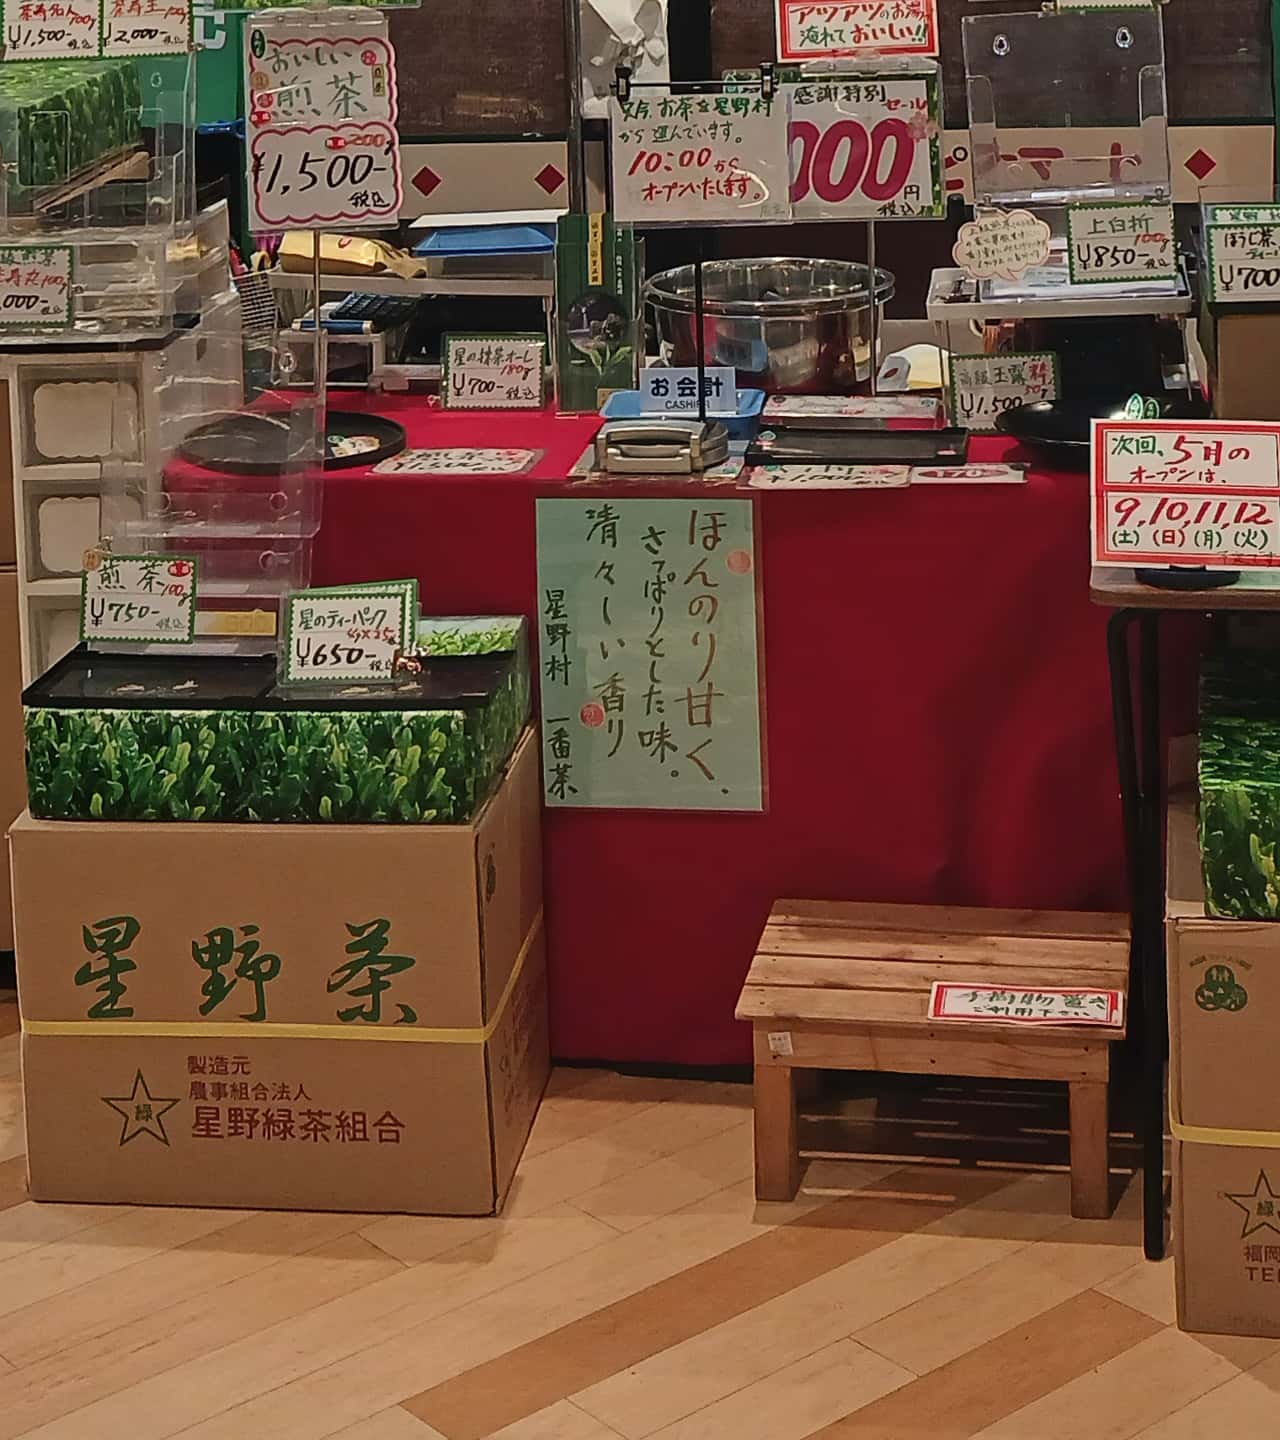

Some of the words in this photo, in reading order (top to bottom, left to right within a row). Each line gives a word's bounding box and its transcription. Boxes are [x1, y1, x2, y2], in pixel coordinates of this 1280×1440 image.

[263, 47, 353, 74] おいしい
[271, 72, 368, 119] 煎茶
[794, 84, 886, 104] 感謝特別
[881, 97, 928, 111] セール
[349, 190, 391, 208] 税込
[904, 185, 921, 201] 円
[1088, 213, 1155, 235] 上白折
[1225, 227, 1277, 248] ほうじ茶
[650, 376, 724, 397] お会計
[1111, 435, 1251, 466] 次回、5月の
[1112, 529, 1140, 547] (土)
[1153, 529, 1186, 548] (日)
[1194, 530, 1222, 549] (月)
[1234, 530, 1269, 549] (火)
[98, 562, 165, 592] 煎茶
[544, 588, 572, 686] 星野村
[546, 715, 578, 800] 一番茶
[74, 915, 419, 1024] 星野茶
[188, 1055, 251, 1076] 製造元
[188, 1081, 312, 1103] 農事組合法人
[191, 1105, 406, 1144] 星野緑茶組合
